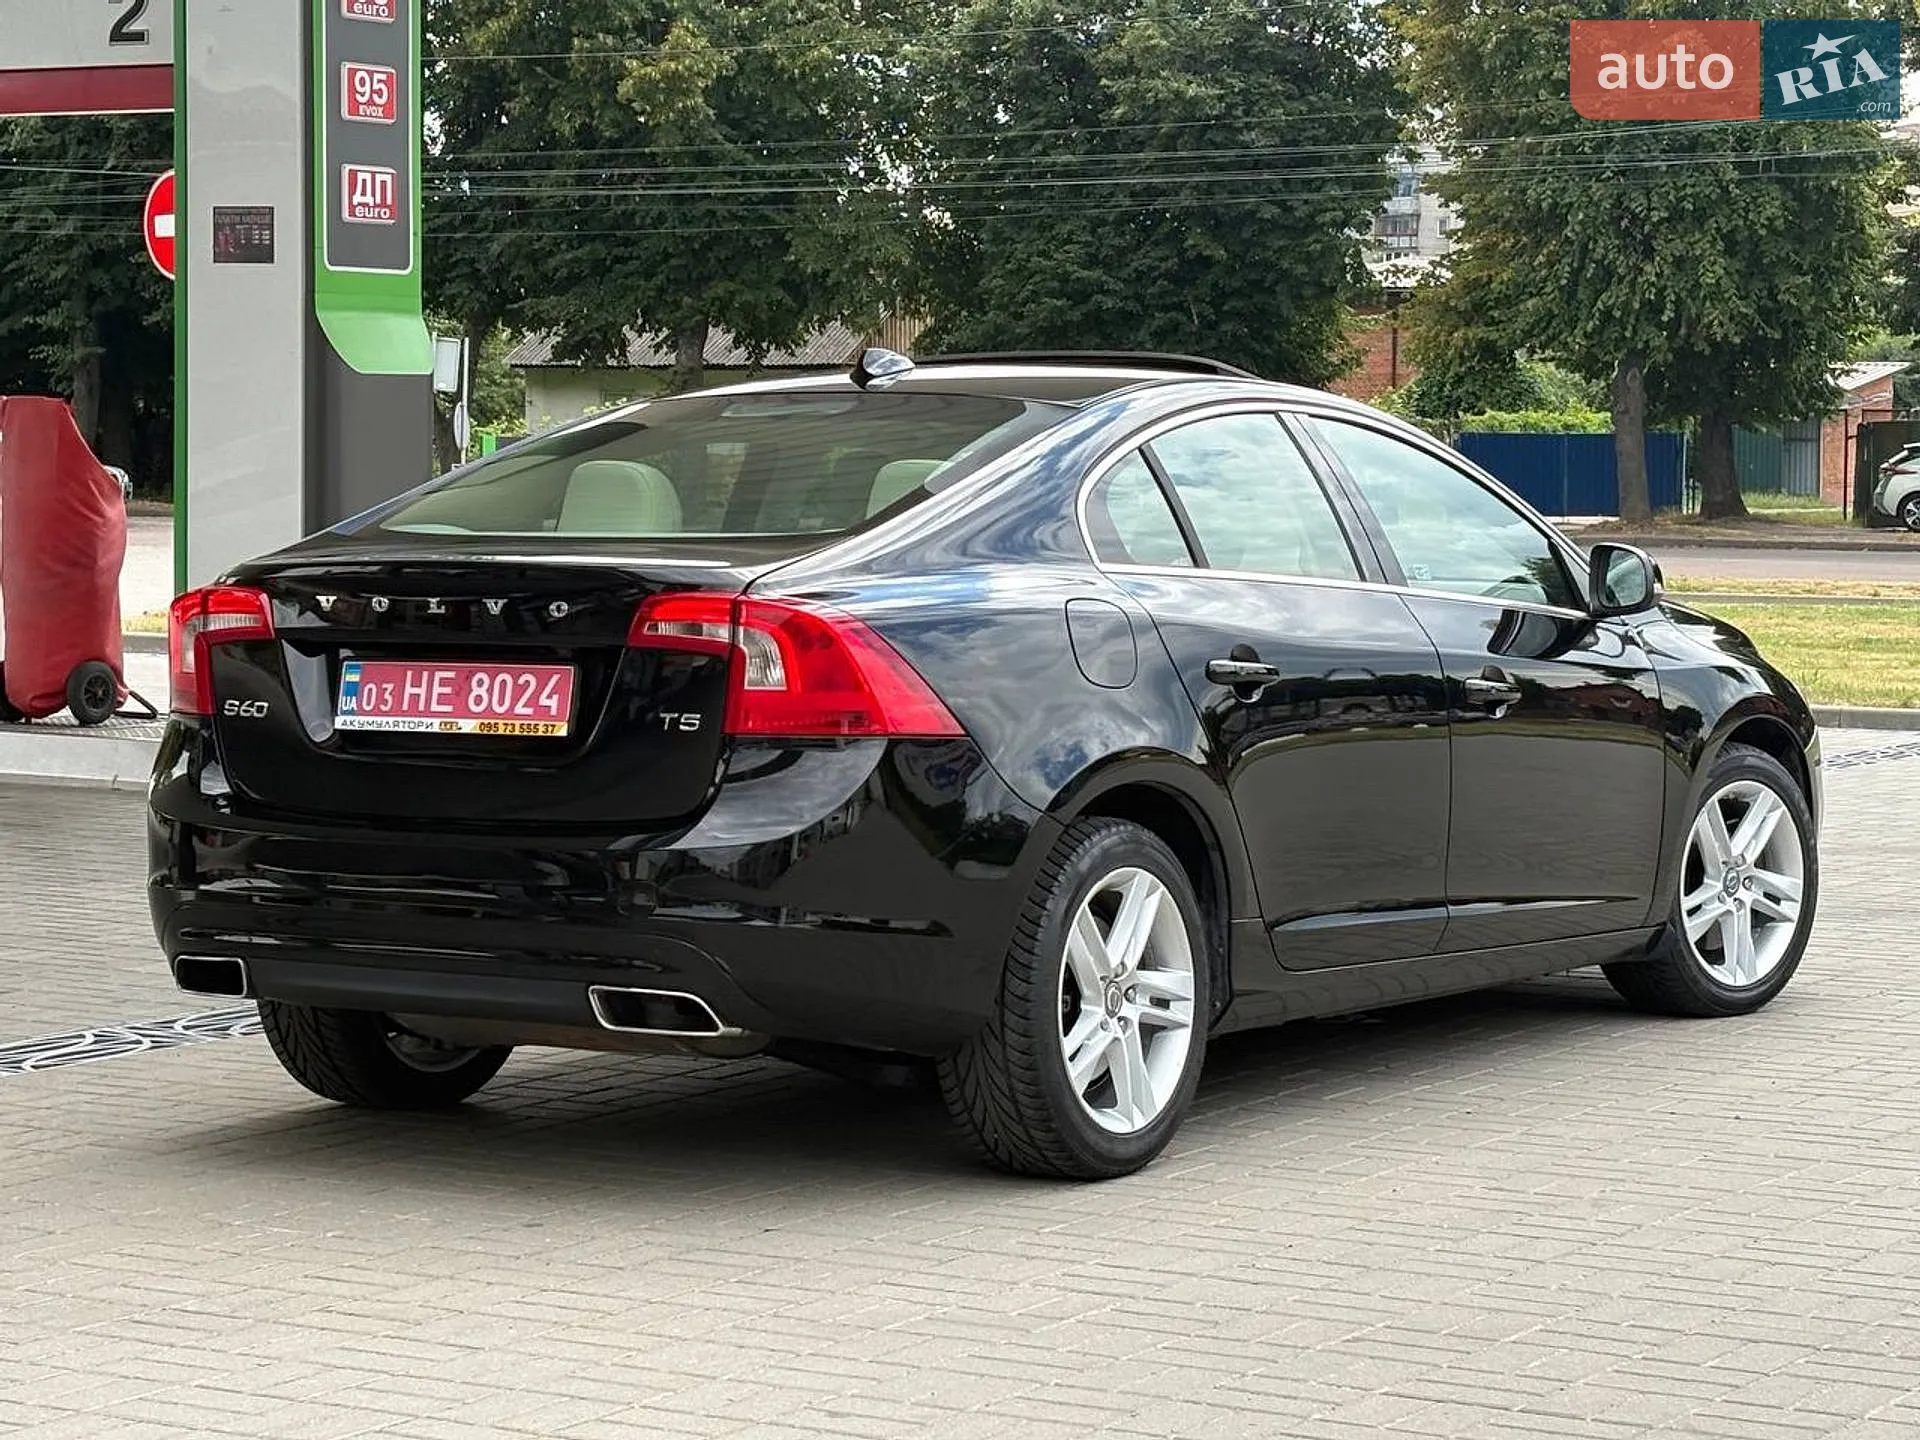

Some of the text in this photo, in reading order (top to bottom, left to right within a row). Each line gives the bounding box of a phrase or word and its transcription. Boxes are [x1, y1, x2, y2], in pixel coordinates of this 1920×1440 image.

[353, 2, 389, 17] euro
[109, 0, 149, 46] 2
[353, 70, 389, 106] 95
[352, 171, 392, 206] ДП
[355, 206, 390, 219] euro
[315, 595, 569, 618] VOLVO
[362, 670, 561, 716] 03 HE 8024
[223, 699, 269, 718] S60
[341, 695, 358, 711] UA
[340, 718, 434, 731] АКУМУЛЯТОРИ
[478, 721, 499, 733] 095
[503, 722, 516, 734] 73
[541, 723, 557, 735] 37
[660, 712, 701, 731] T5
